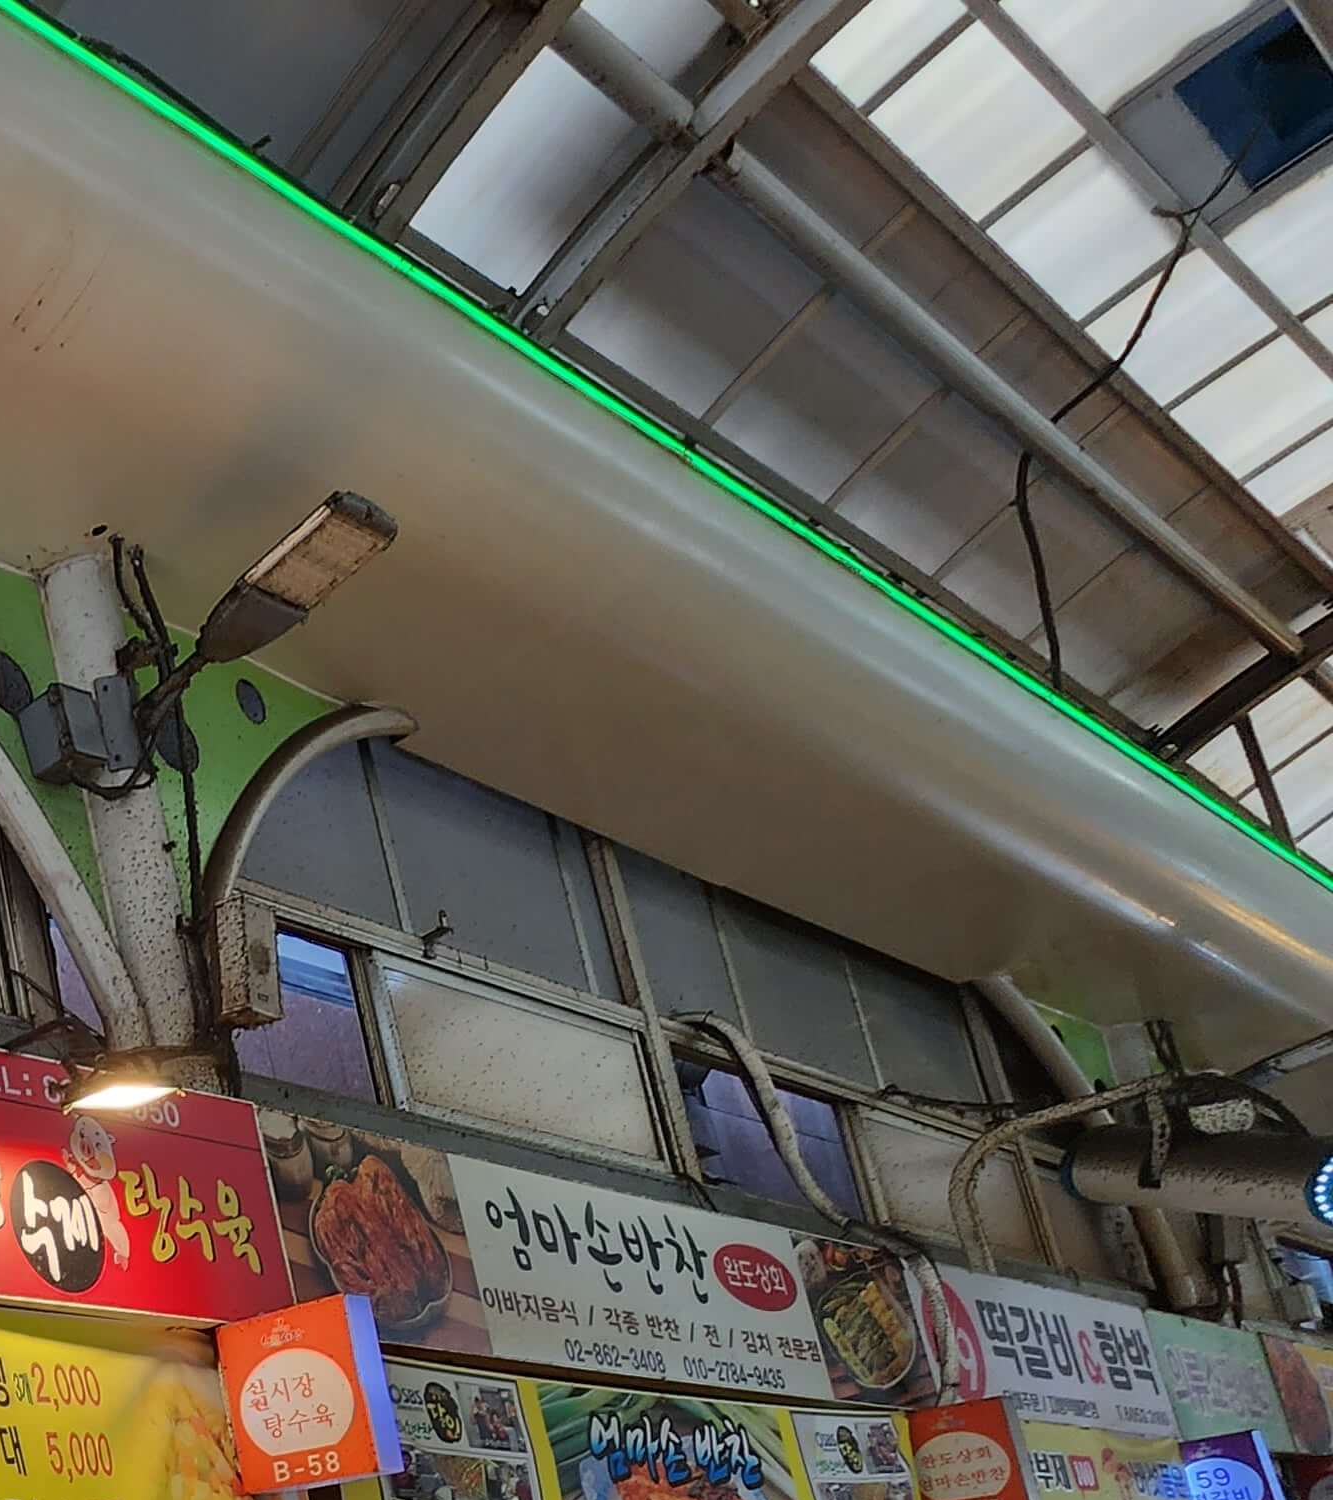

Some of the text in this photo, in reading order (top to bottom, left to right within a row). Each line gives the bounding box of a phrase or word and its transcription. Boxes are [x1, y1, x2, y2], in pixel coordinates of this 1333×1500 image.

[484, 1184, 789, 1305] 엄마손반찬 완도상회
[482, 1287, 580, 1327] 이바지음식
[645, 1312, 682, 1343] 반찬
[703, 1324, 722, 1349] 전
[741, 1330, 774, 1358] 김치
[564, 1337, 666, 1375] 02-862-3408
[31, 1361, 102, 1413] 2,000
[263, 1402, 337, 1439] 탕수육
[45, 1430, 113, 1485] 5,000
[272, 1450, 341, 1483] B-58
[588, 1411, 687, 1488] 엄마손
